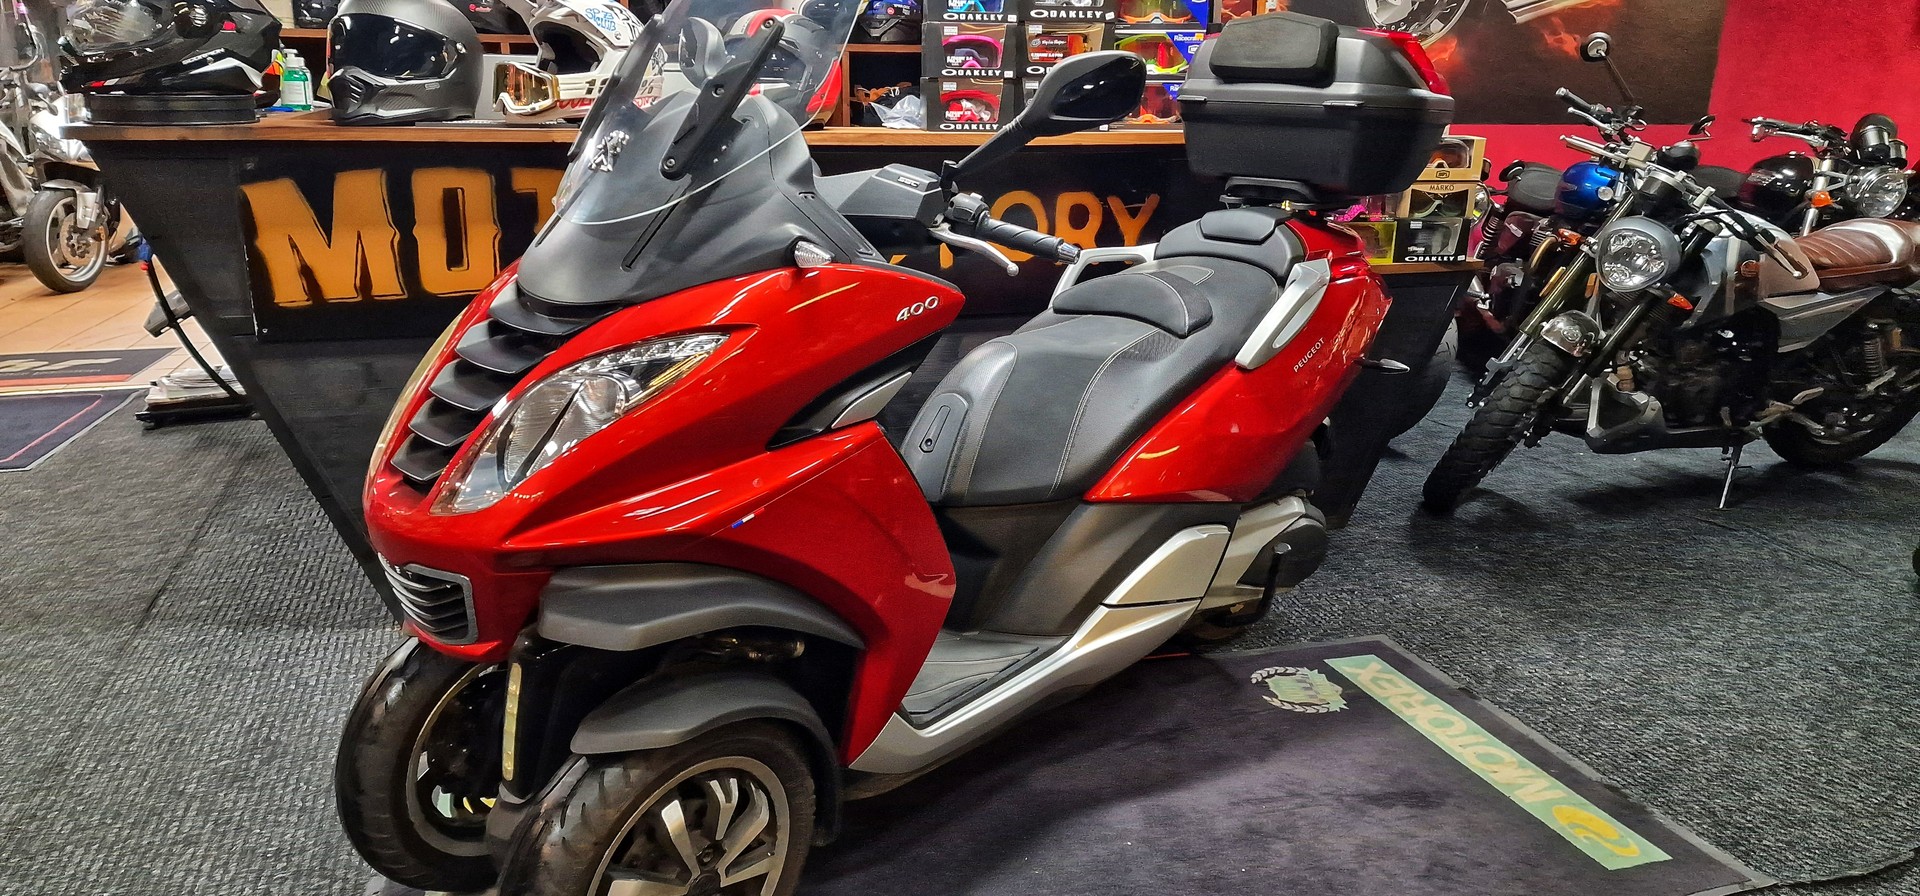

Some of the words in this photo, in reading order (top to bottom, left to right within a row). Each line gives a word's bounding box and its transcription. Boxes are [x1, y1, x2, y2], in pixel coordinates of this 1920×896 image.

[1049, 10, 1103, 19] OAKLEY
[896, 295, 939, 322] 400
[1293, 337, 1325, 373] PEUGEOT
[1343, 661, 1569, 804] MOTOREX
